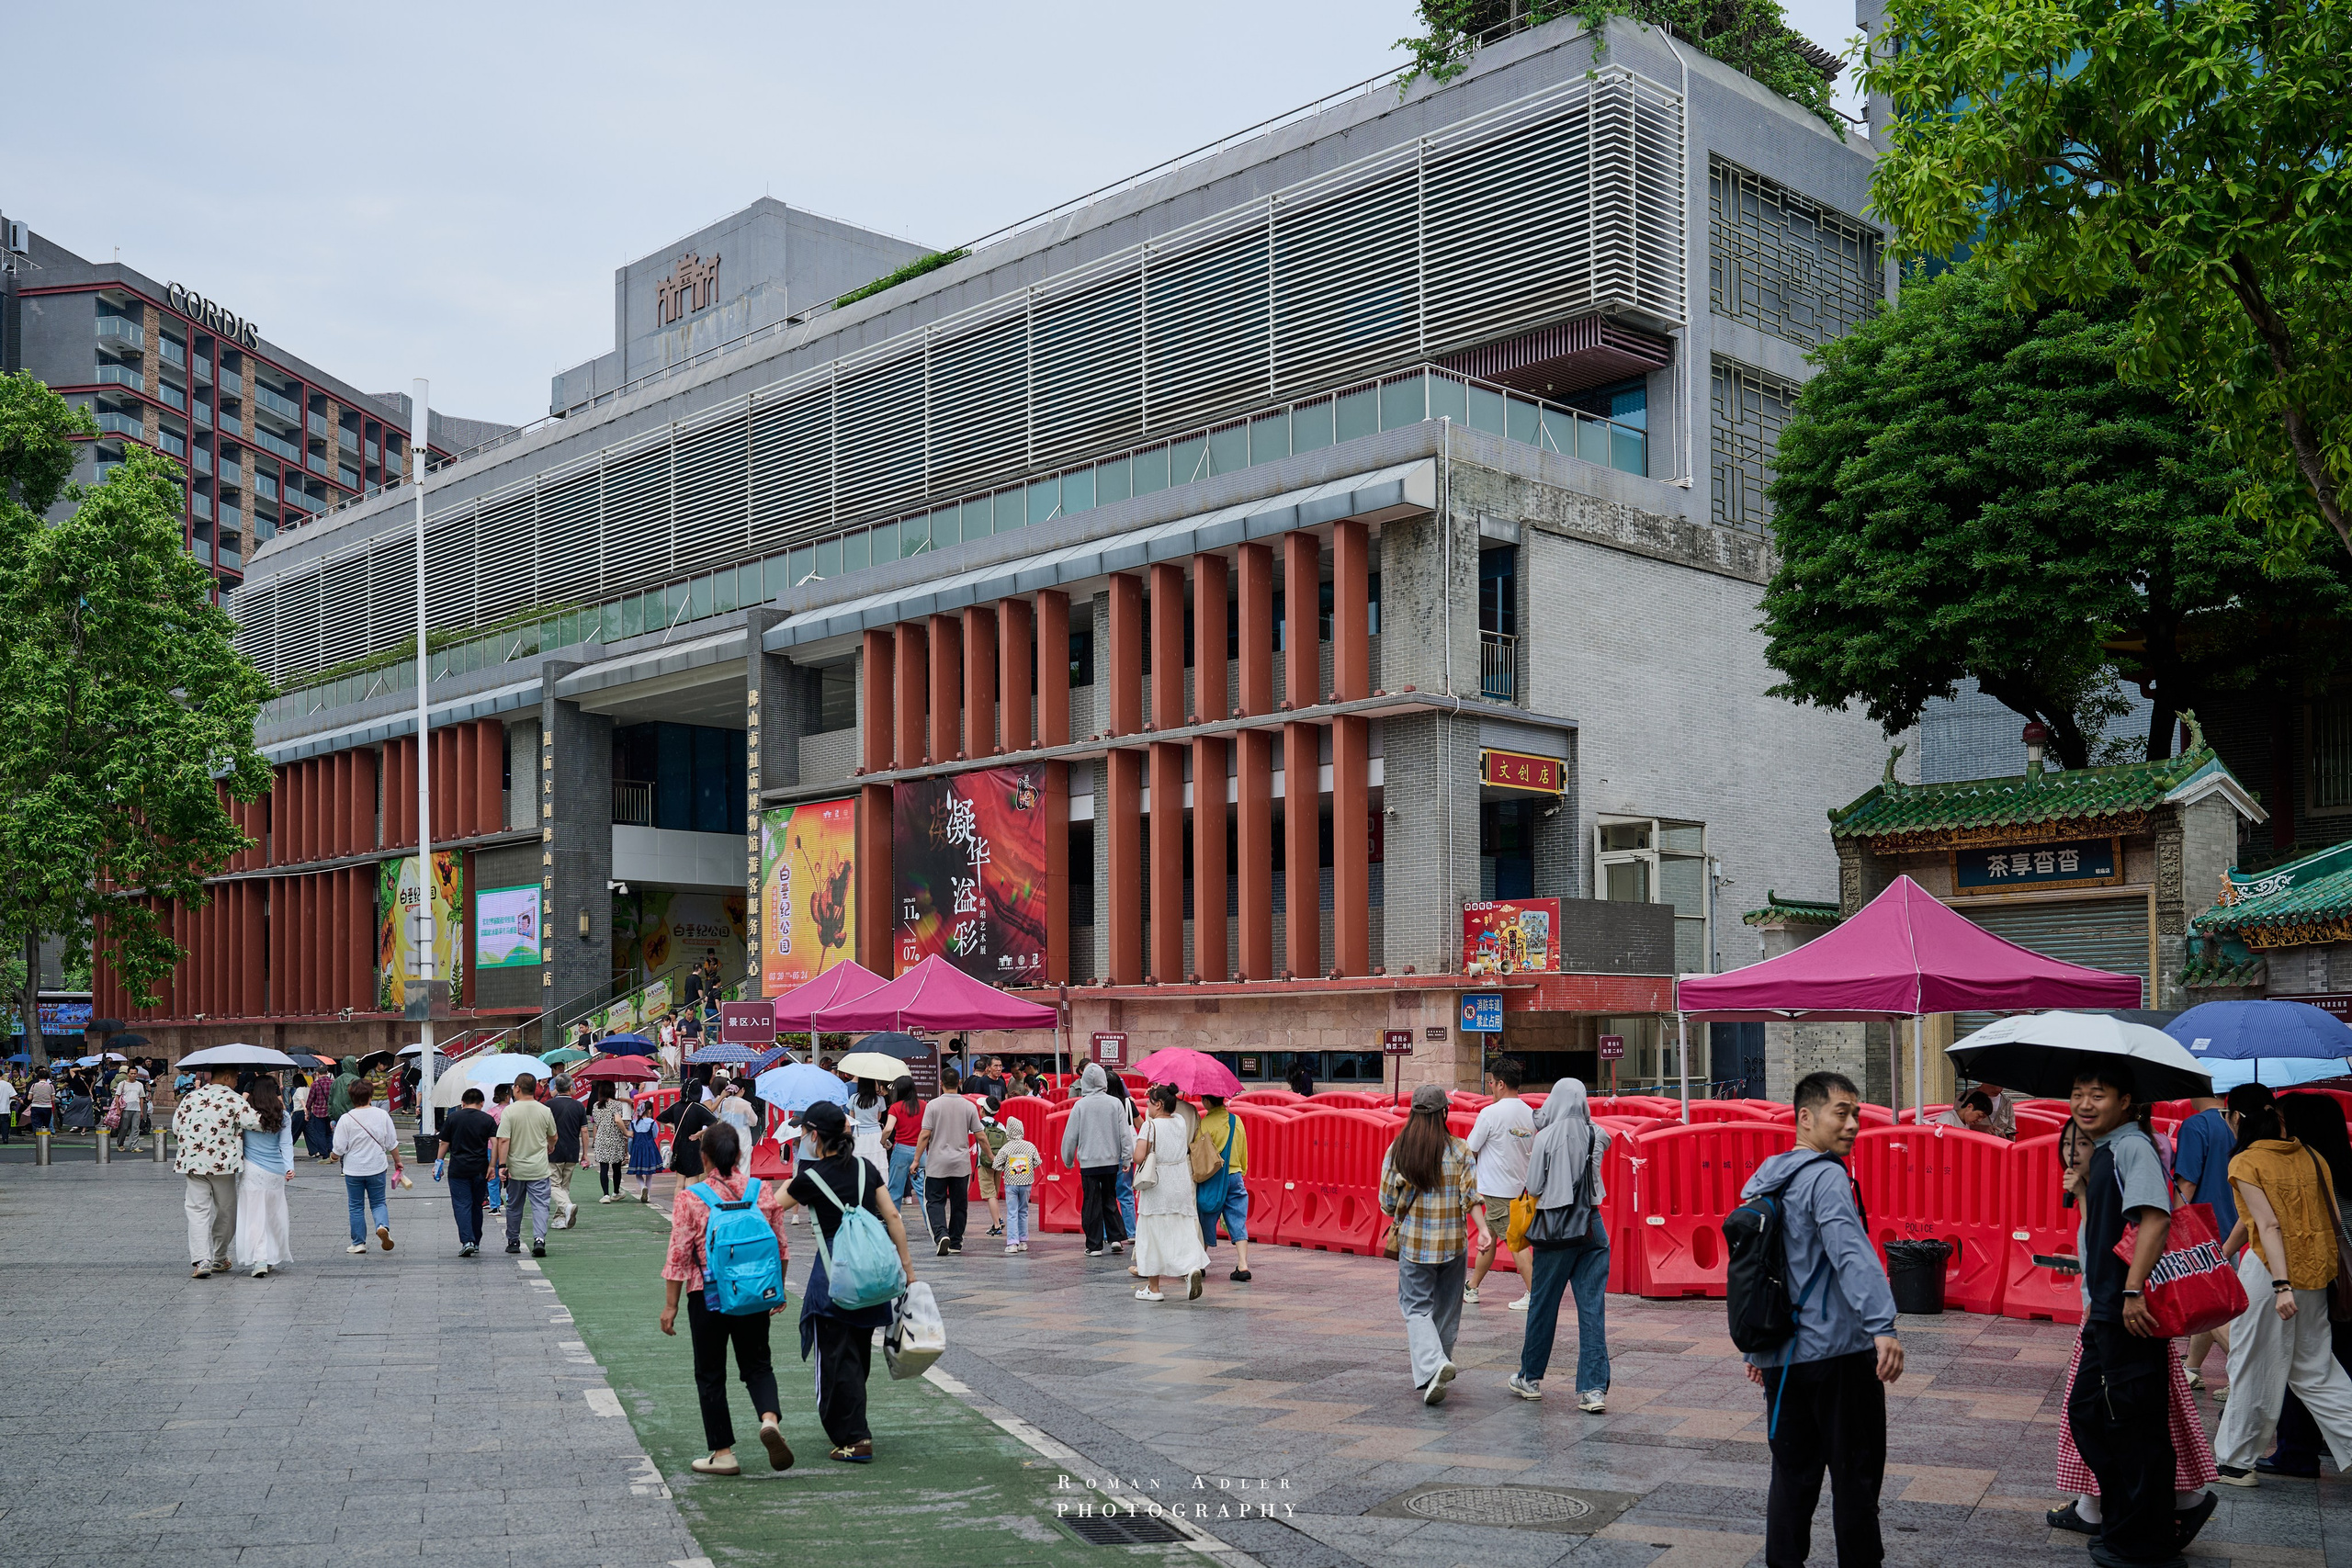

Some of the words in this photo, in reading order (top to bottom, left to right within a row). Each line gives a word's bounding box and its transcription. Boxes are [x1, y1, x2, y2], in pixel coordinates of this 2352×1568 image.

[167, 281, 259, 350] CORDIS
[1498, 760, 1549, 784] 文创店
[748, 690, 759, 976] 佛山市祖庙博物馆游客服务中心
[401, 886, 436, 904] 白垩纪园
[1476, 998, 1500, 1011] 消防车道
[729, 1017, 770, 1027] 景区入口
[1476, 1014, 1500, 1028] 禁止占用
[1321, 1186, 1338, 1194] POLICE
[1905, 1223, 1933, 1233] POLICE
